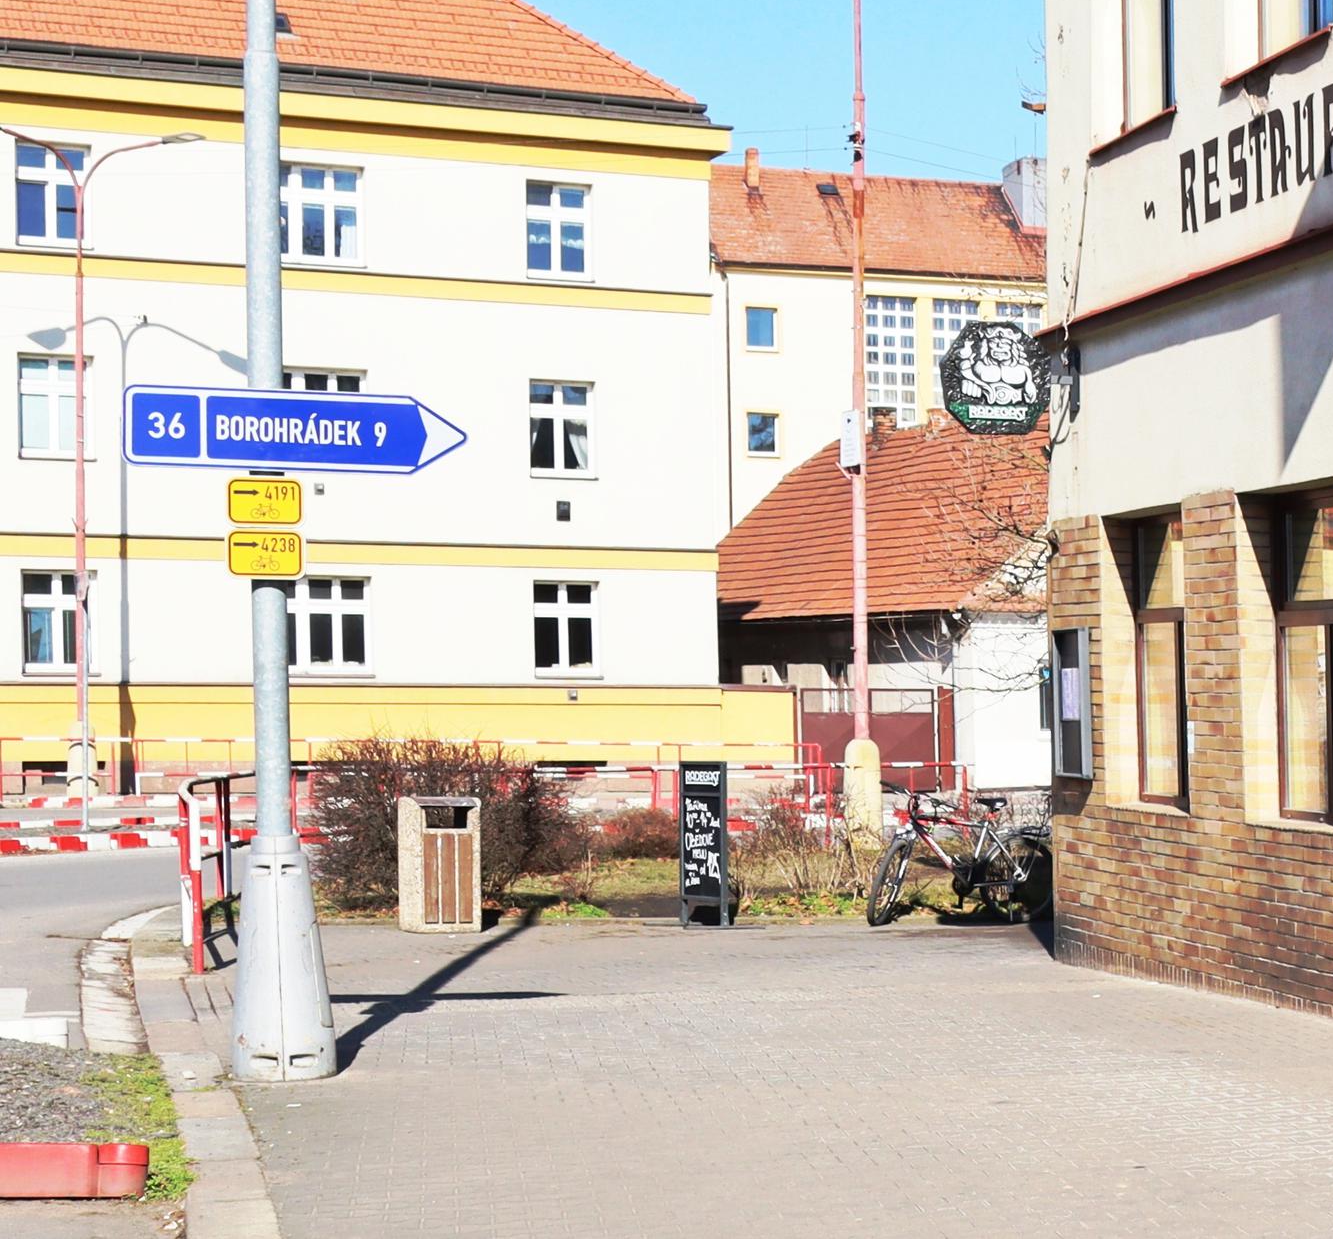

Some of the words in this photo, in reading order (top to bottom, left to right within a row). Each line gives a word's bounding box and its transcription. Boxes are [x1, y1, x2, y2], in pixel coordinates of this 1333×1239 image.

[968, 404, 1028, 421] RADEGAST
[147, 411, 186, 440] 36
[215, 413, 362, 447] BOROHRÁDEK
[374, 422, 388, 448] 9
[265, 486, 296, 501] 4191
[261, 537, 296, 553] 4238
[685, 770, 720, 786] RADEGAST
